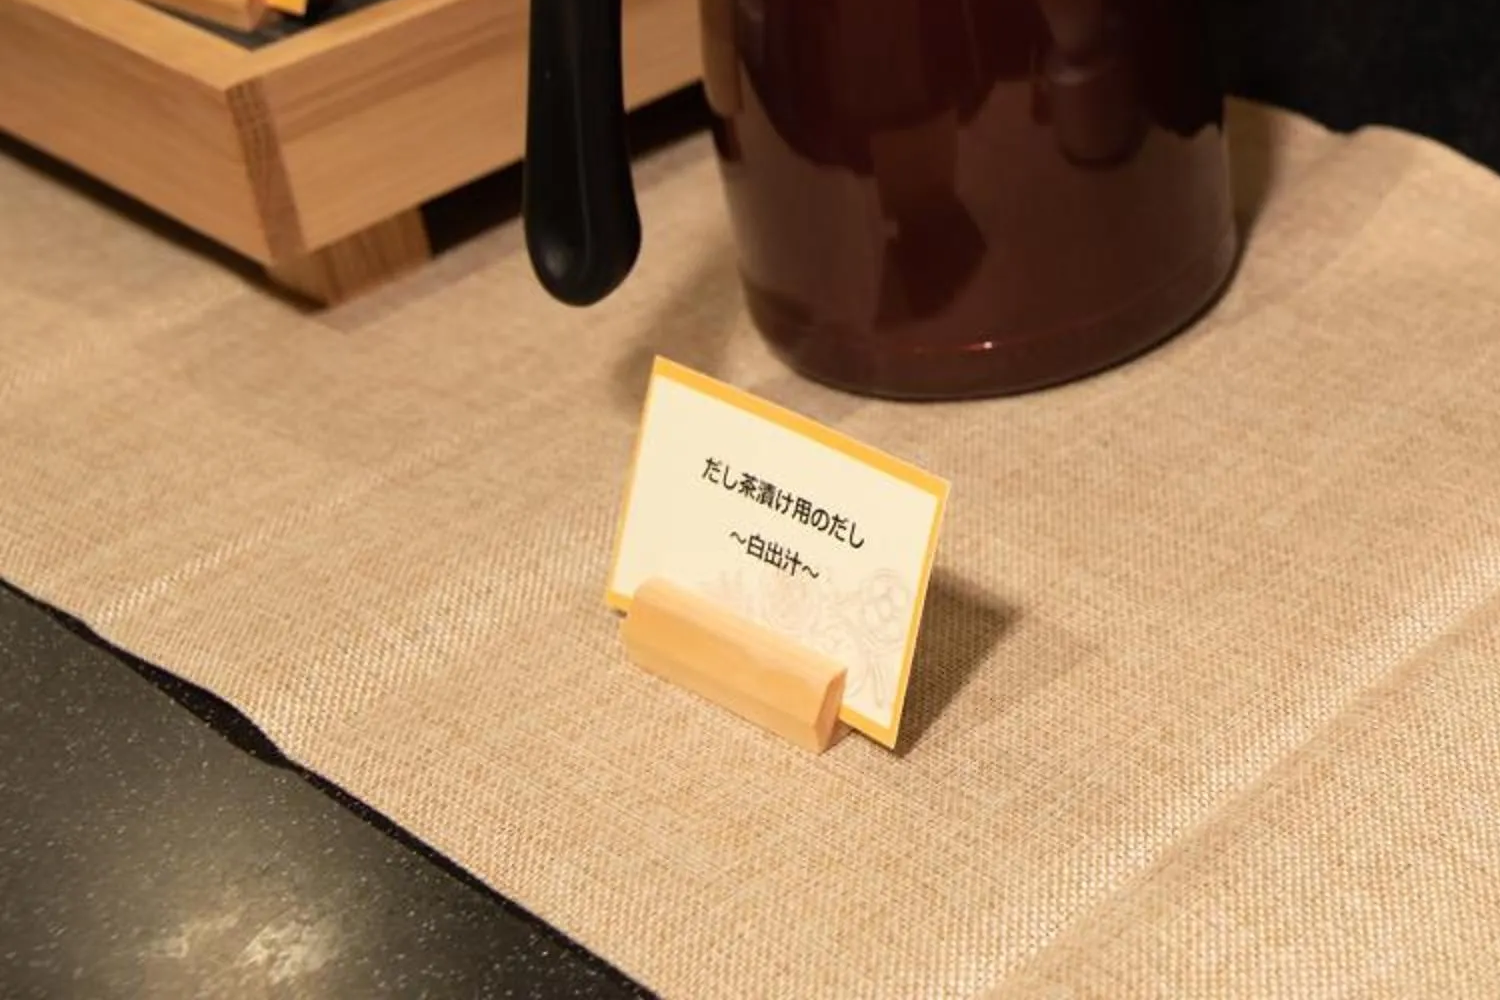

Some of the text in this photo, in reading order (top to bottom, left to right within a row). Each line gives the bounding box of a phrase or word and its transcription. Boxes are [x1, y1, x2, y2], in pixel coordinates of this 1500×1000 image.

[702, 457, 865, 549] だし茶漬け用のだし
